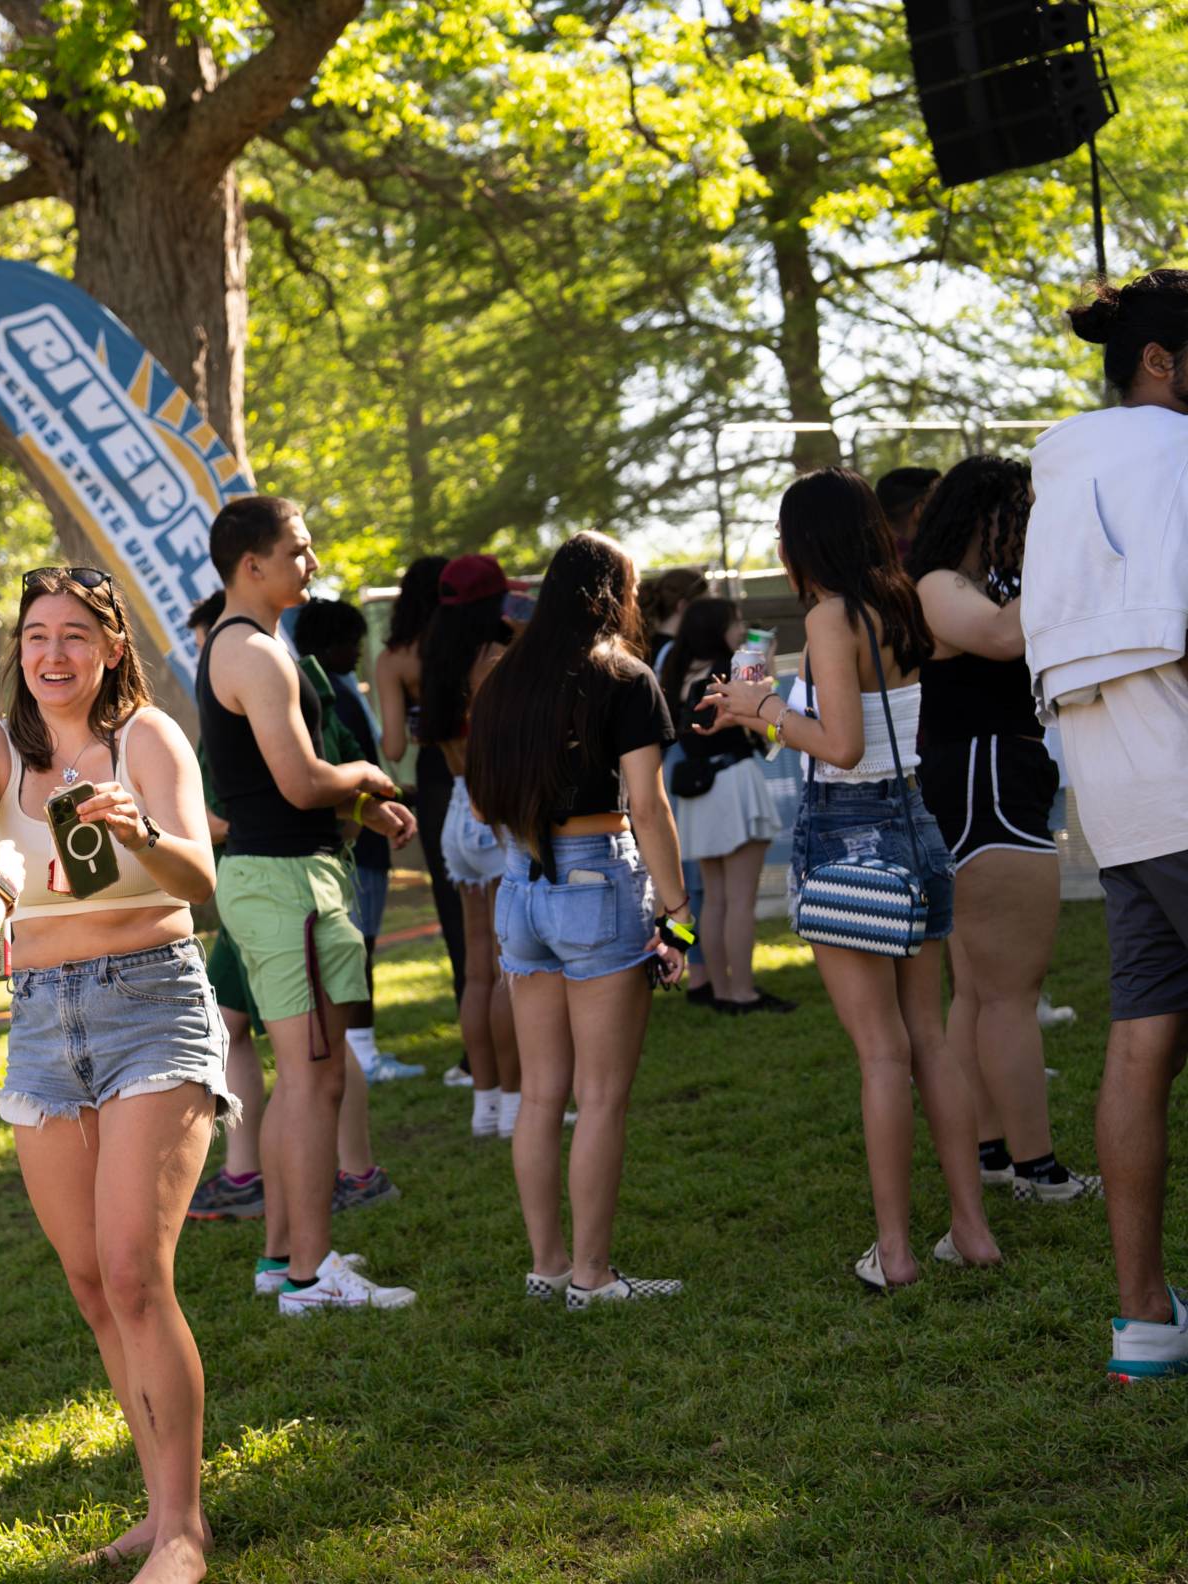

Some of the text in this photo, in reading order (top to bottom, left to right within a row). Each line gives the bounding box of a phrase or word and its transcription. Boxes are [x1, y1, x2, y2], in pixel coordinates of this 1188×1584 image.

[10, 316, 184, 522] RIVER
[59, 451, 127, 534] STATE
[124, 537, 198, 662] UNIVERS
